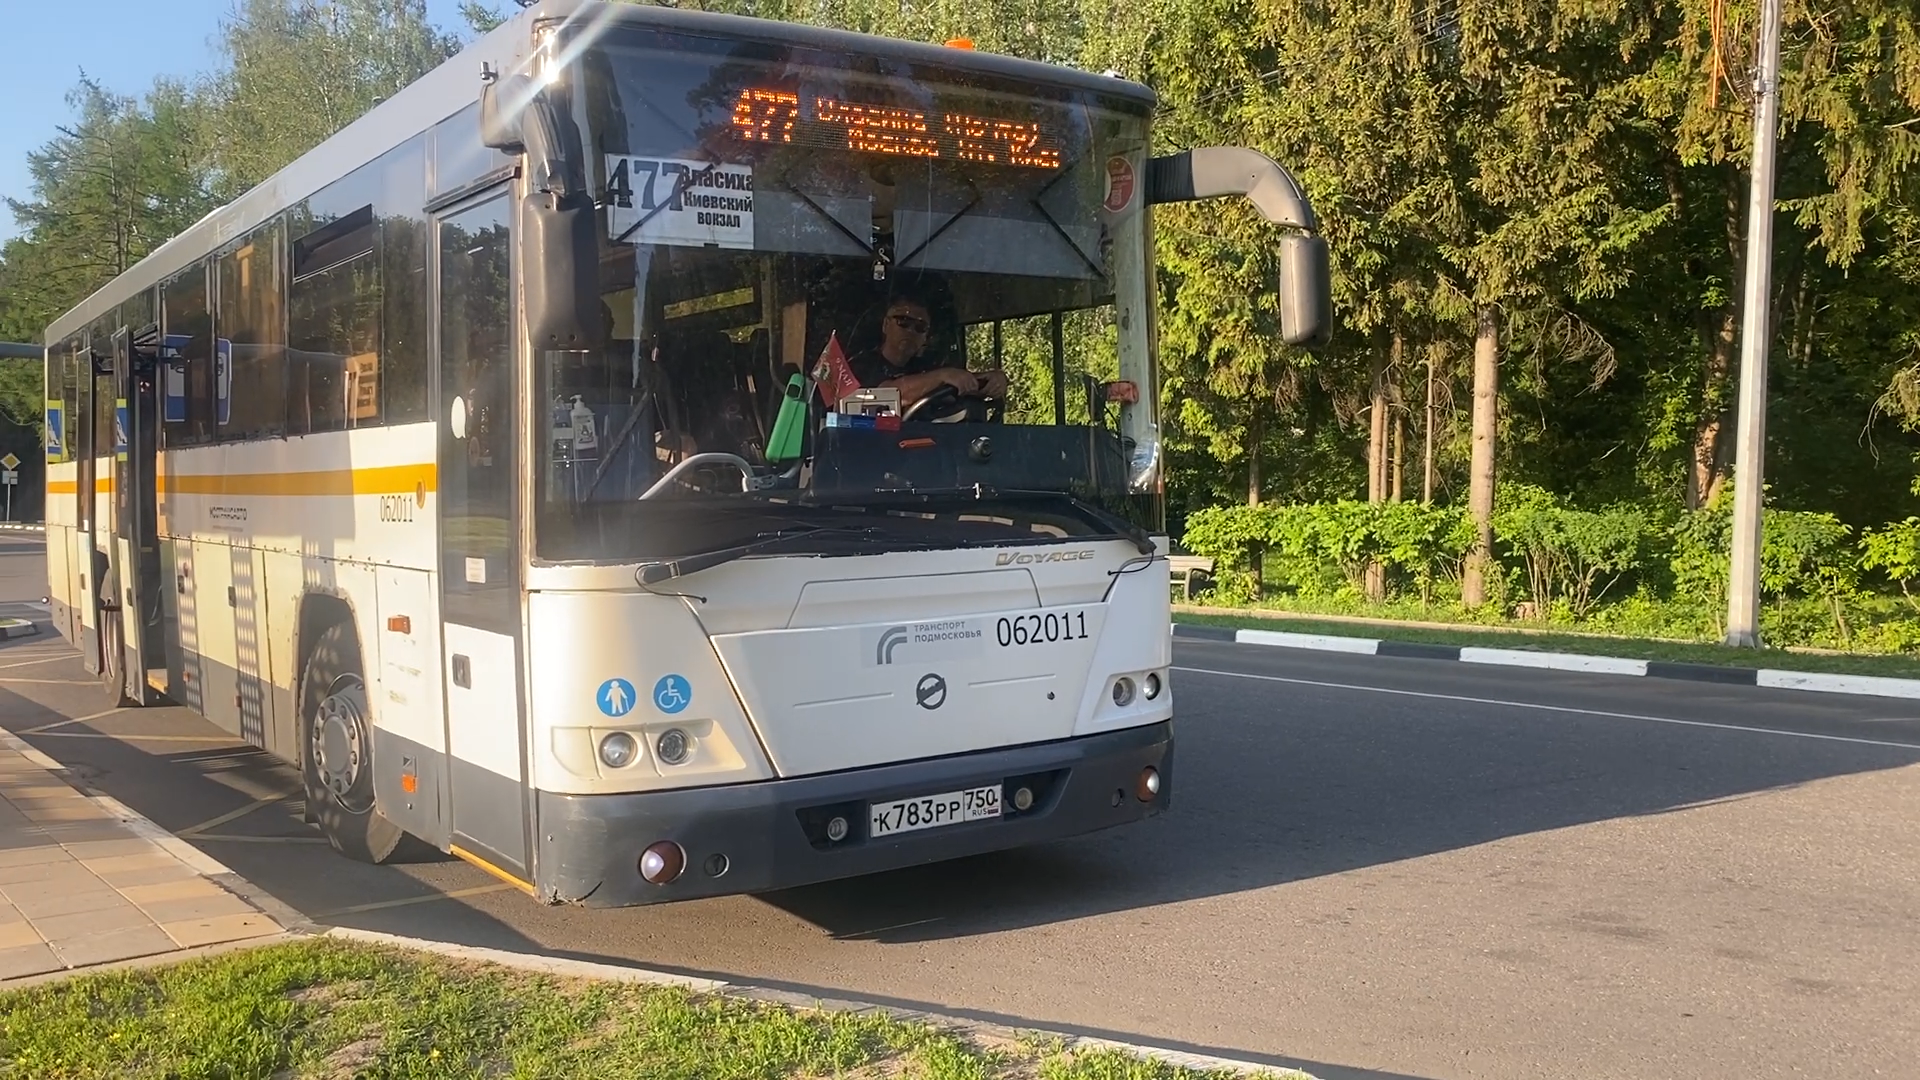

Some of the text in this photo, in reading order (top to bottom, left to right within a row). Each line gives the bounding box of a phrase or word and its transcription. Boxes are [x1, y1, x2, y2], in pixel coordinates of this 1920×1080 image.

[732, 88, 798, 142] 477
[605, 158, 683, 212] 477
[683, 191, 753, 213] Киевский
[380, 495, 413, 523] 062011
[913, 621, 966, 633] ТРАНСПОРТ
[914, 629, 982, 643] ПОДМОСКОВЬЯ
[996, 611, 1089, 647] 062011
[965, 788, 996, 810] 750
[972, 809, 988, 817] RUS
